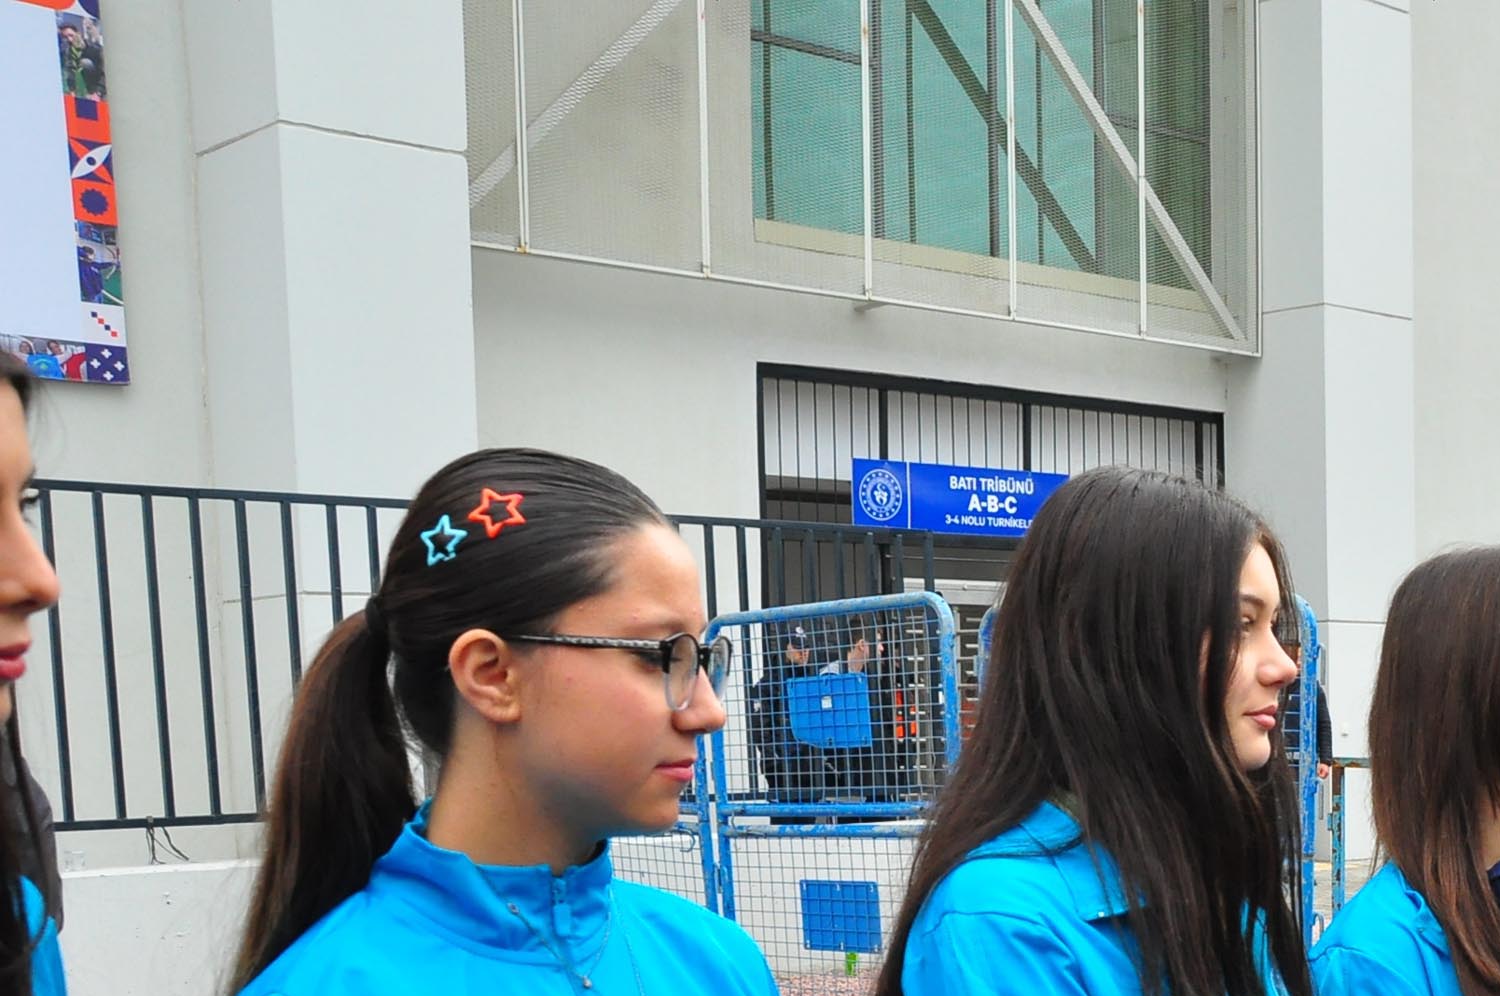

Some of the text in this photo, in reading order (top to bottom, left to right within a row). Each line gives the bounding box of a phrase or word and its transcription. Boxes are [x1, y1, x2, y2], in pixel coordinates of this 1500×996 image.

[949, 475, 1034, 495] BATI TRİBÜNÜ
[968, 494, 1017, 514] A-B-C
[945, 514, 959, 525] 3-4
[961, 515, 985, 527] NOLU
